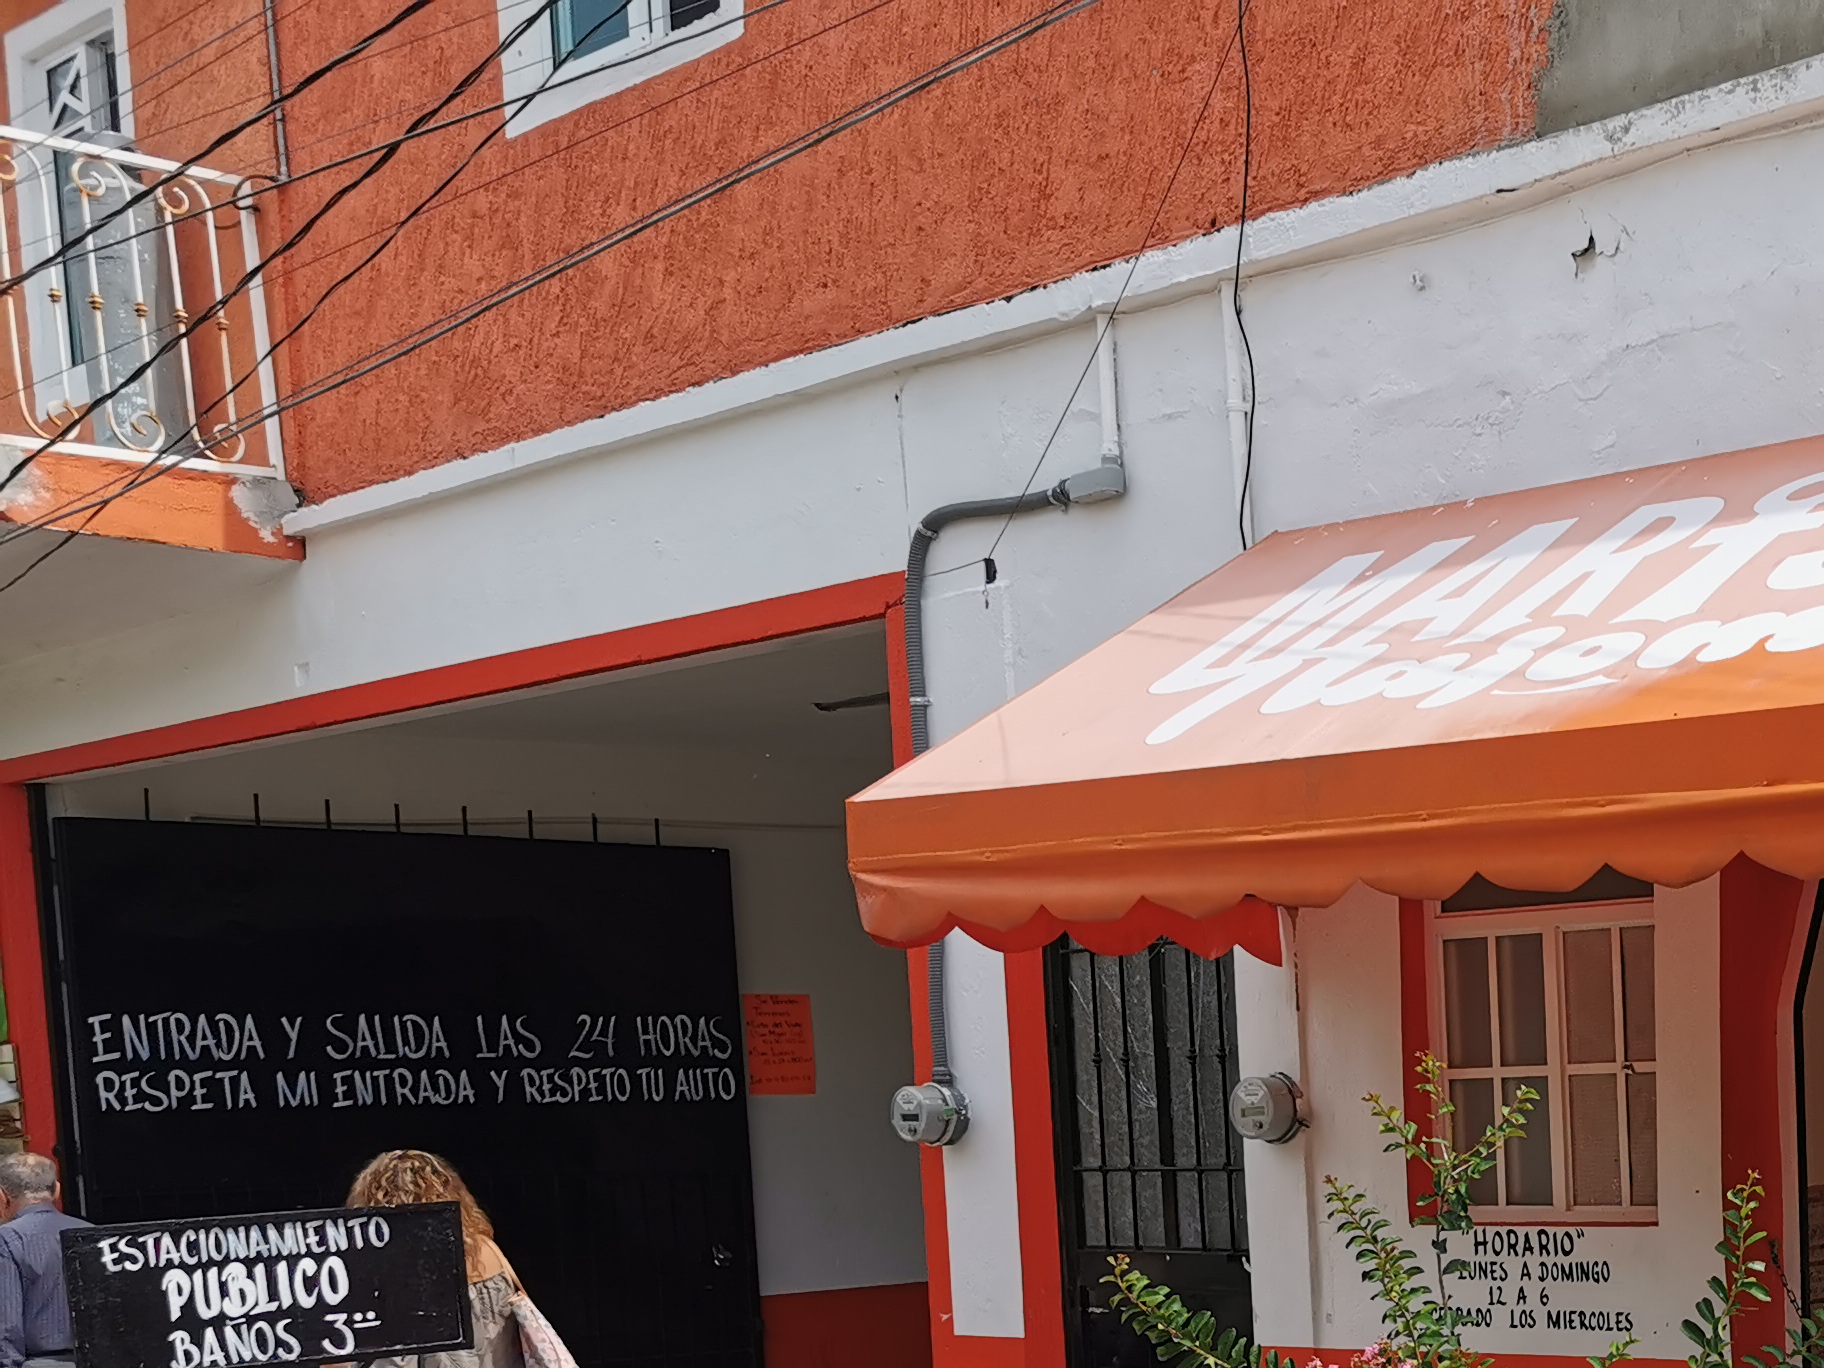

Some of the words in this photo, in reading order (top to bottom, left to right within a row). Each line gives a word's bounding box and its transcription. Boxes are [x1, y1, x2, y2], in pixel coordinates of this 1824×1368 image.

[87, 1011, 266, 1063] ENTRADA
[280, 1015, 303, 1061] Y
[325, 1012, 451, 1061] SALIDA
[475, 1013, 542, 1059] LAS
[567, 1013, 617, 1059] 24
[636, 1013, 733, 1060] HORAS
[95, 1068, 258, 1113] RESPETA
[275, 1070, 319, 1109] MI
[332, 1066, 476, 1109] ENTRADA
[489, 1069, 509, 1104] Y
[519, 1066, 631, 1104] RESPETO
[636, 1066, 664, 1103] TU
[674, 1066, 737, 1103] AUTO
[97, 1215, 391, 1273] ESTACIONAMIENTO
[160, 1254, 350, 1323] PUBLICO
[1487, 1285, 1508, 1307] 12
[1515, 1285, 1528, 1307] A
[1539, 1286, 1550, 1307] 6
[1520, 1260, 1532, 1282] A
[1537, 1260, 1611, 1285] DOMINGO
[1508, 1308, 1537, 1329] LOS
[1546, 1309, 1635, 1333] MIERCOLES
